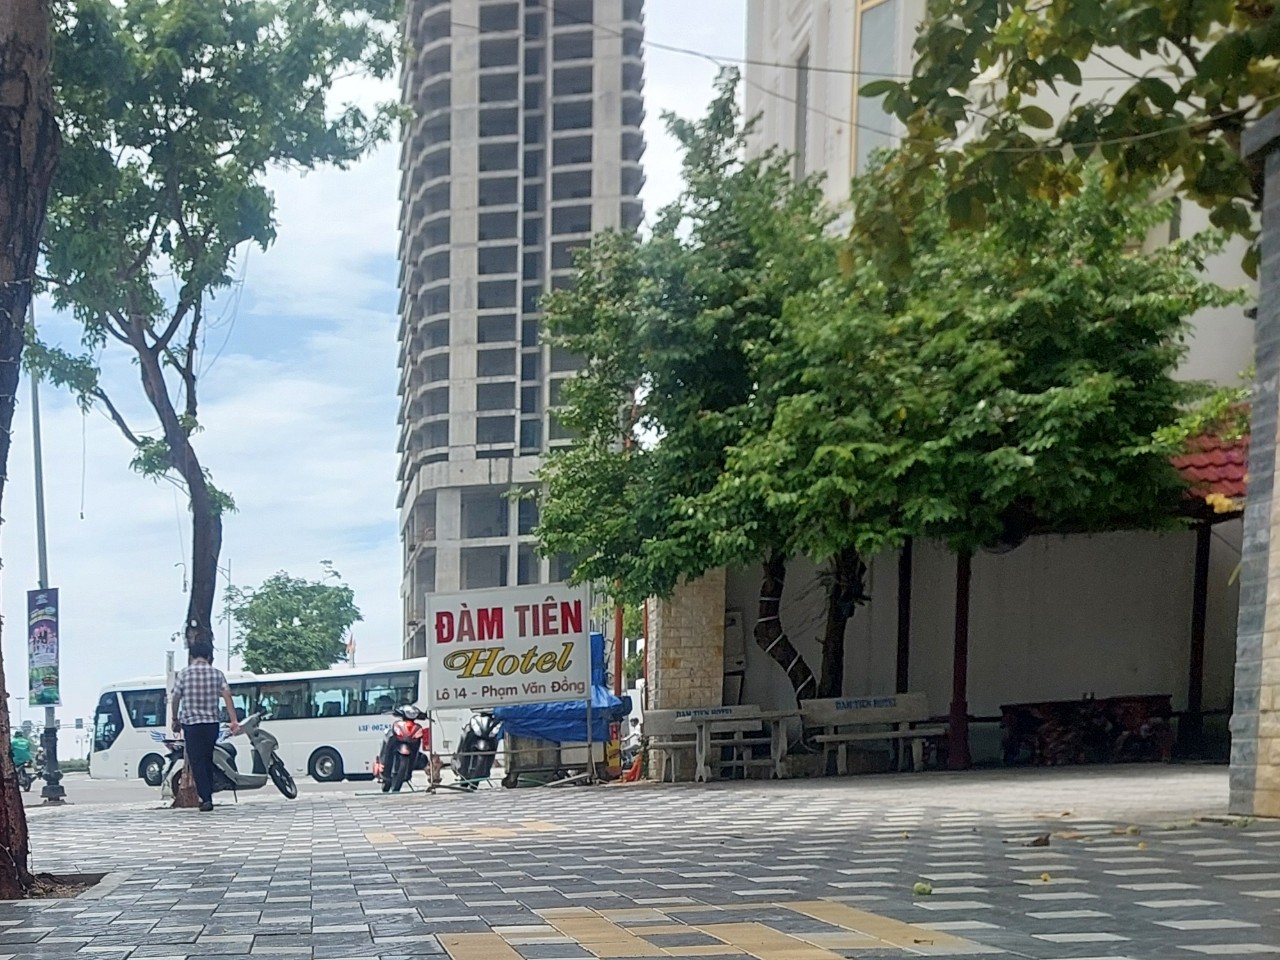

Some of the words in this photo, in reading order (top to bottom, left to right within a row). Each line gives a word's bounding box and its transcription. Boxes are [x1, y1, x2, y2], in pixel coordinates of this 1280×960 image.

[435, 603, 504, 644] ĐÀM
[514, 595, 583, 638] TIÊN
[443, 642, 574, 679] Hotel
[436, 688, 450, 701] Lô
[453, 687, 468, 699] 14
[481, 685, 518, 700] Phạm
[522, 681, 546, 695] Văn
[550, 676, 585, 694] Đồng
